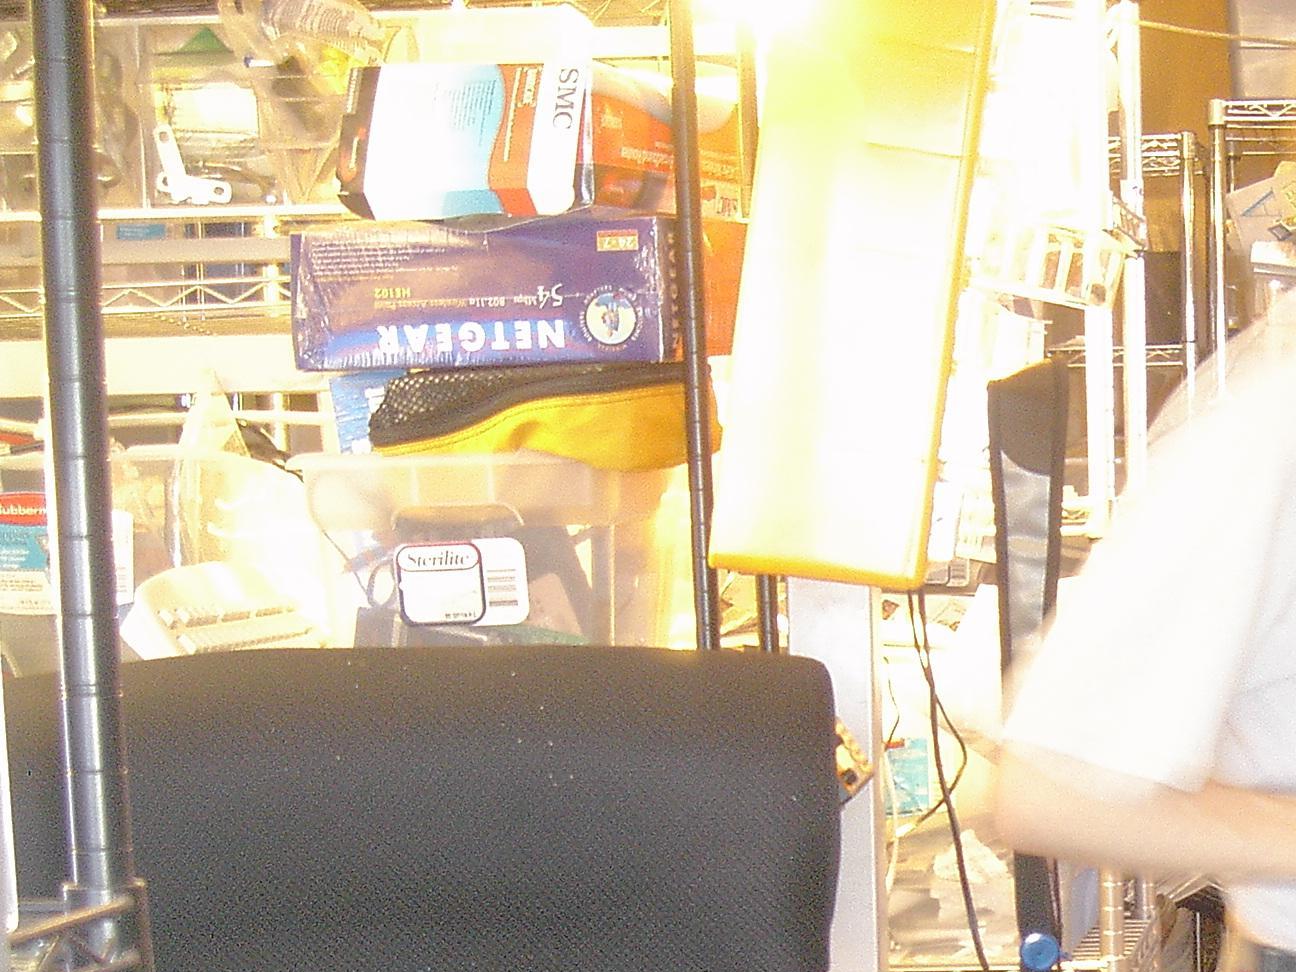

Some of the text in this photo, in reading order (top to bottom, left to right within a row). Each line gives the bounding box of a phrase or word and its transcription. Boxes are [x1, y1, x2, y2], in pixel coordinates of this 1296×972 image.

[552, 68, 579, 130] SMC
[537, 283, 564, 308] 54
[376, 319, 565, 354] NETGEAR
[406, 550, 470, 567] Sterilite
